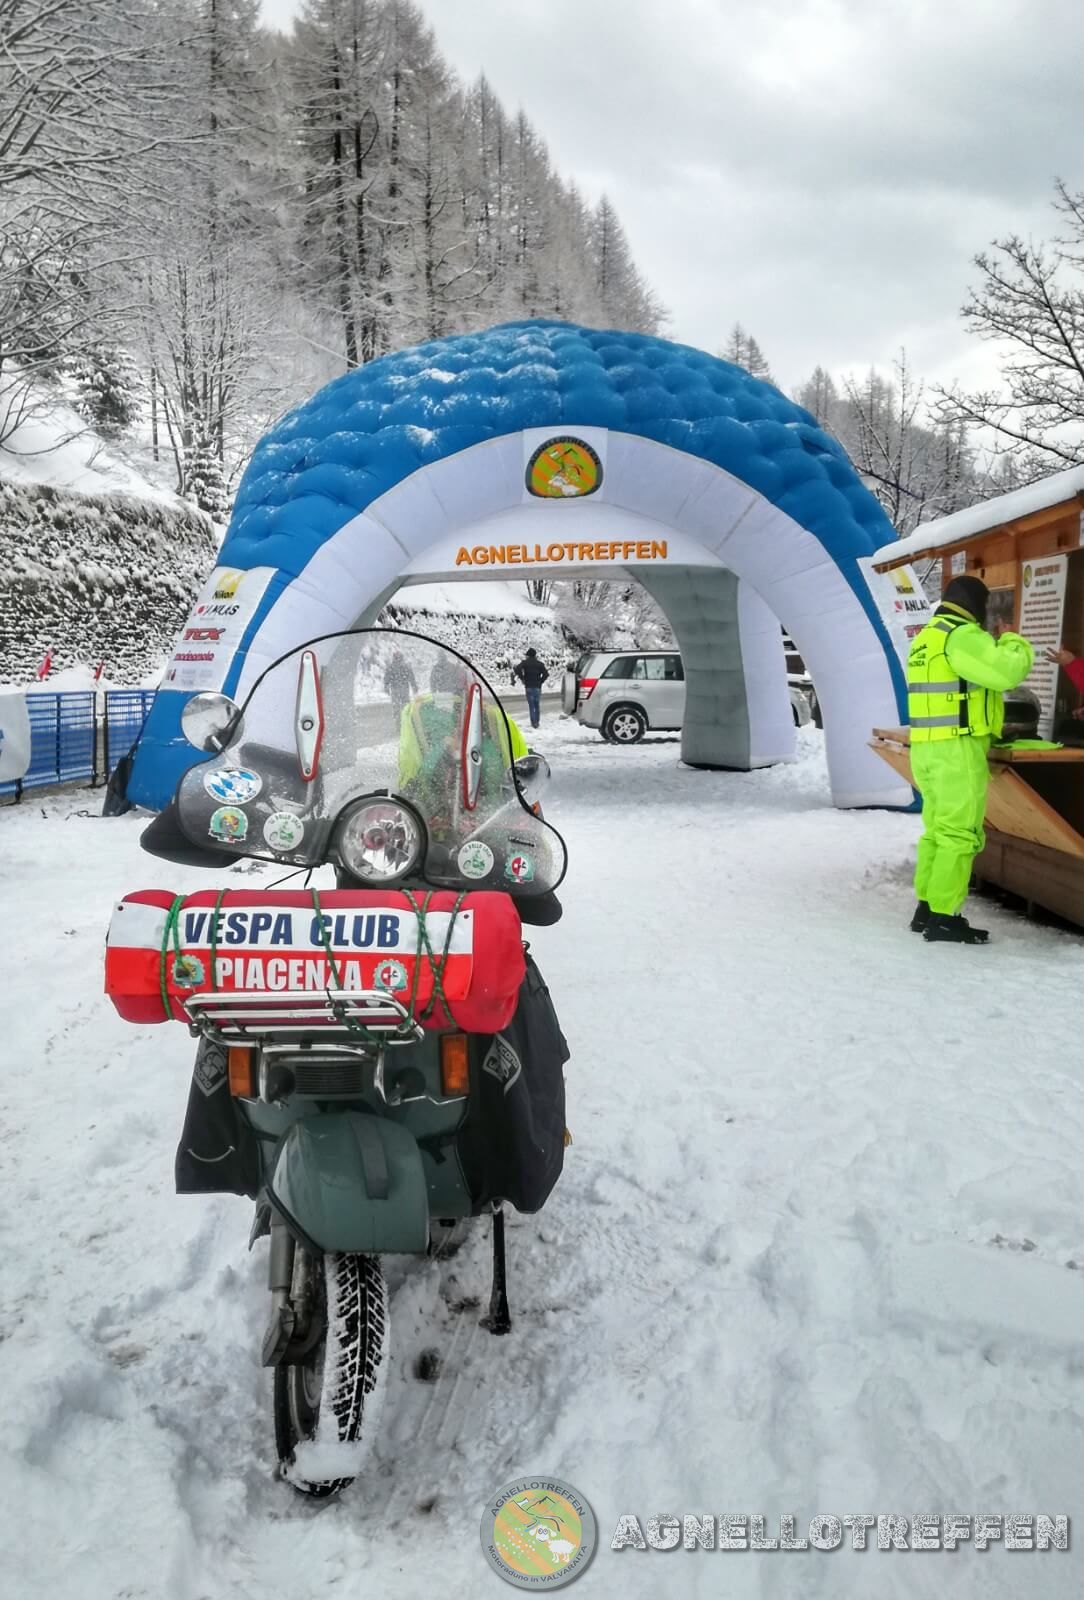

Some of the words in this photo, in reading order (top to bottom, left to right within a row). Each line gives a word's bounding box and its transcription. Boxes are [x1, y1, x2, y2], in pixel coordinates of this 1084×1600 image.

[455, 540, 668, 566] AGNELLOTREFFEN
[184, 911, 294, 946] VESPA
[309, 914, 400, 948] CLUB
[215, 956, 364, 992] PIACENZA
